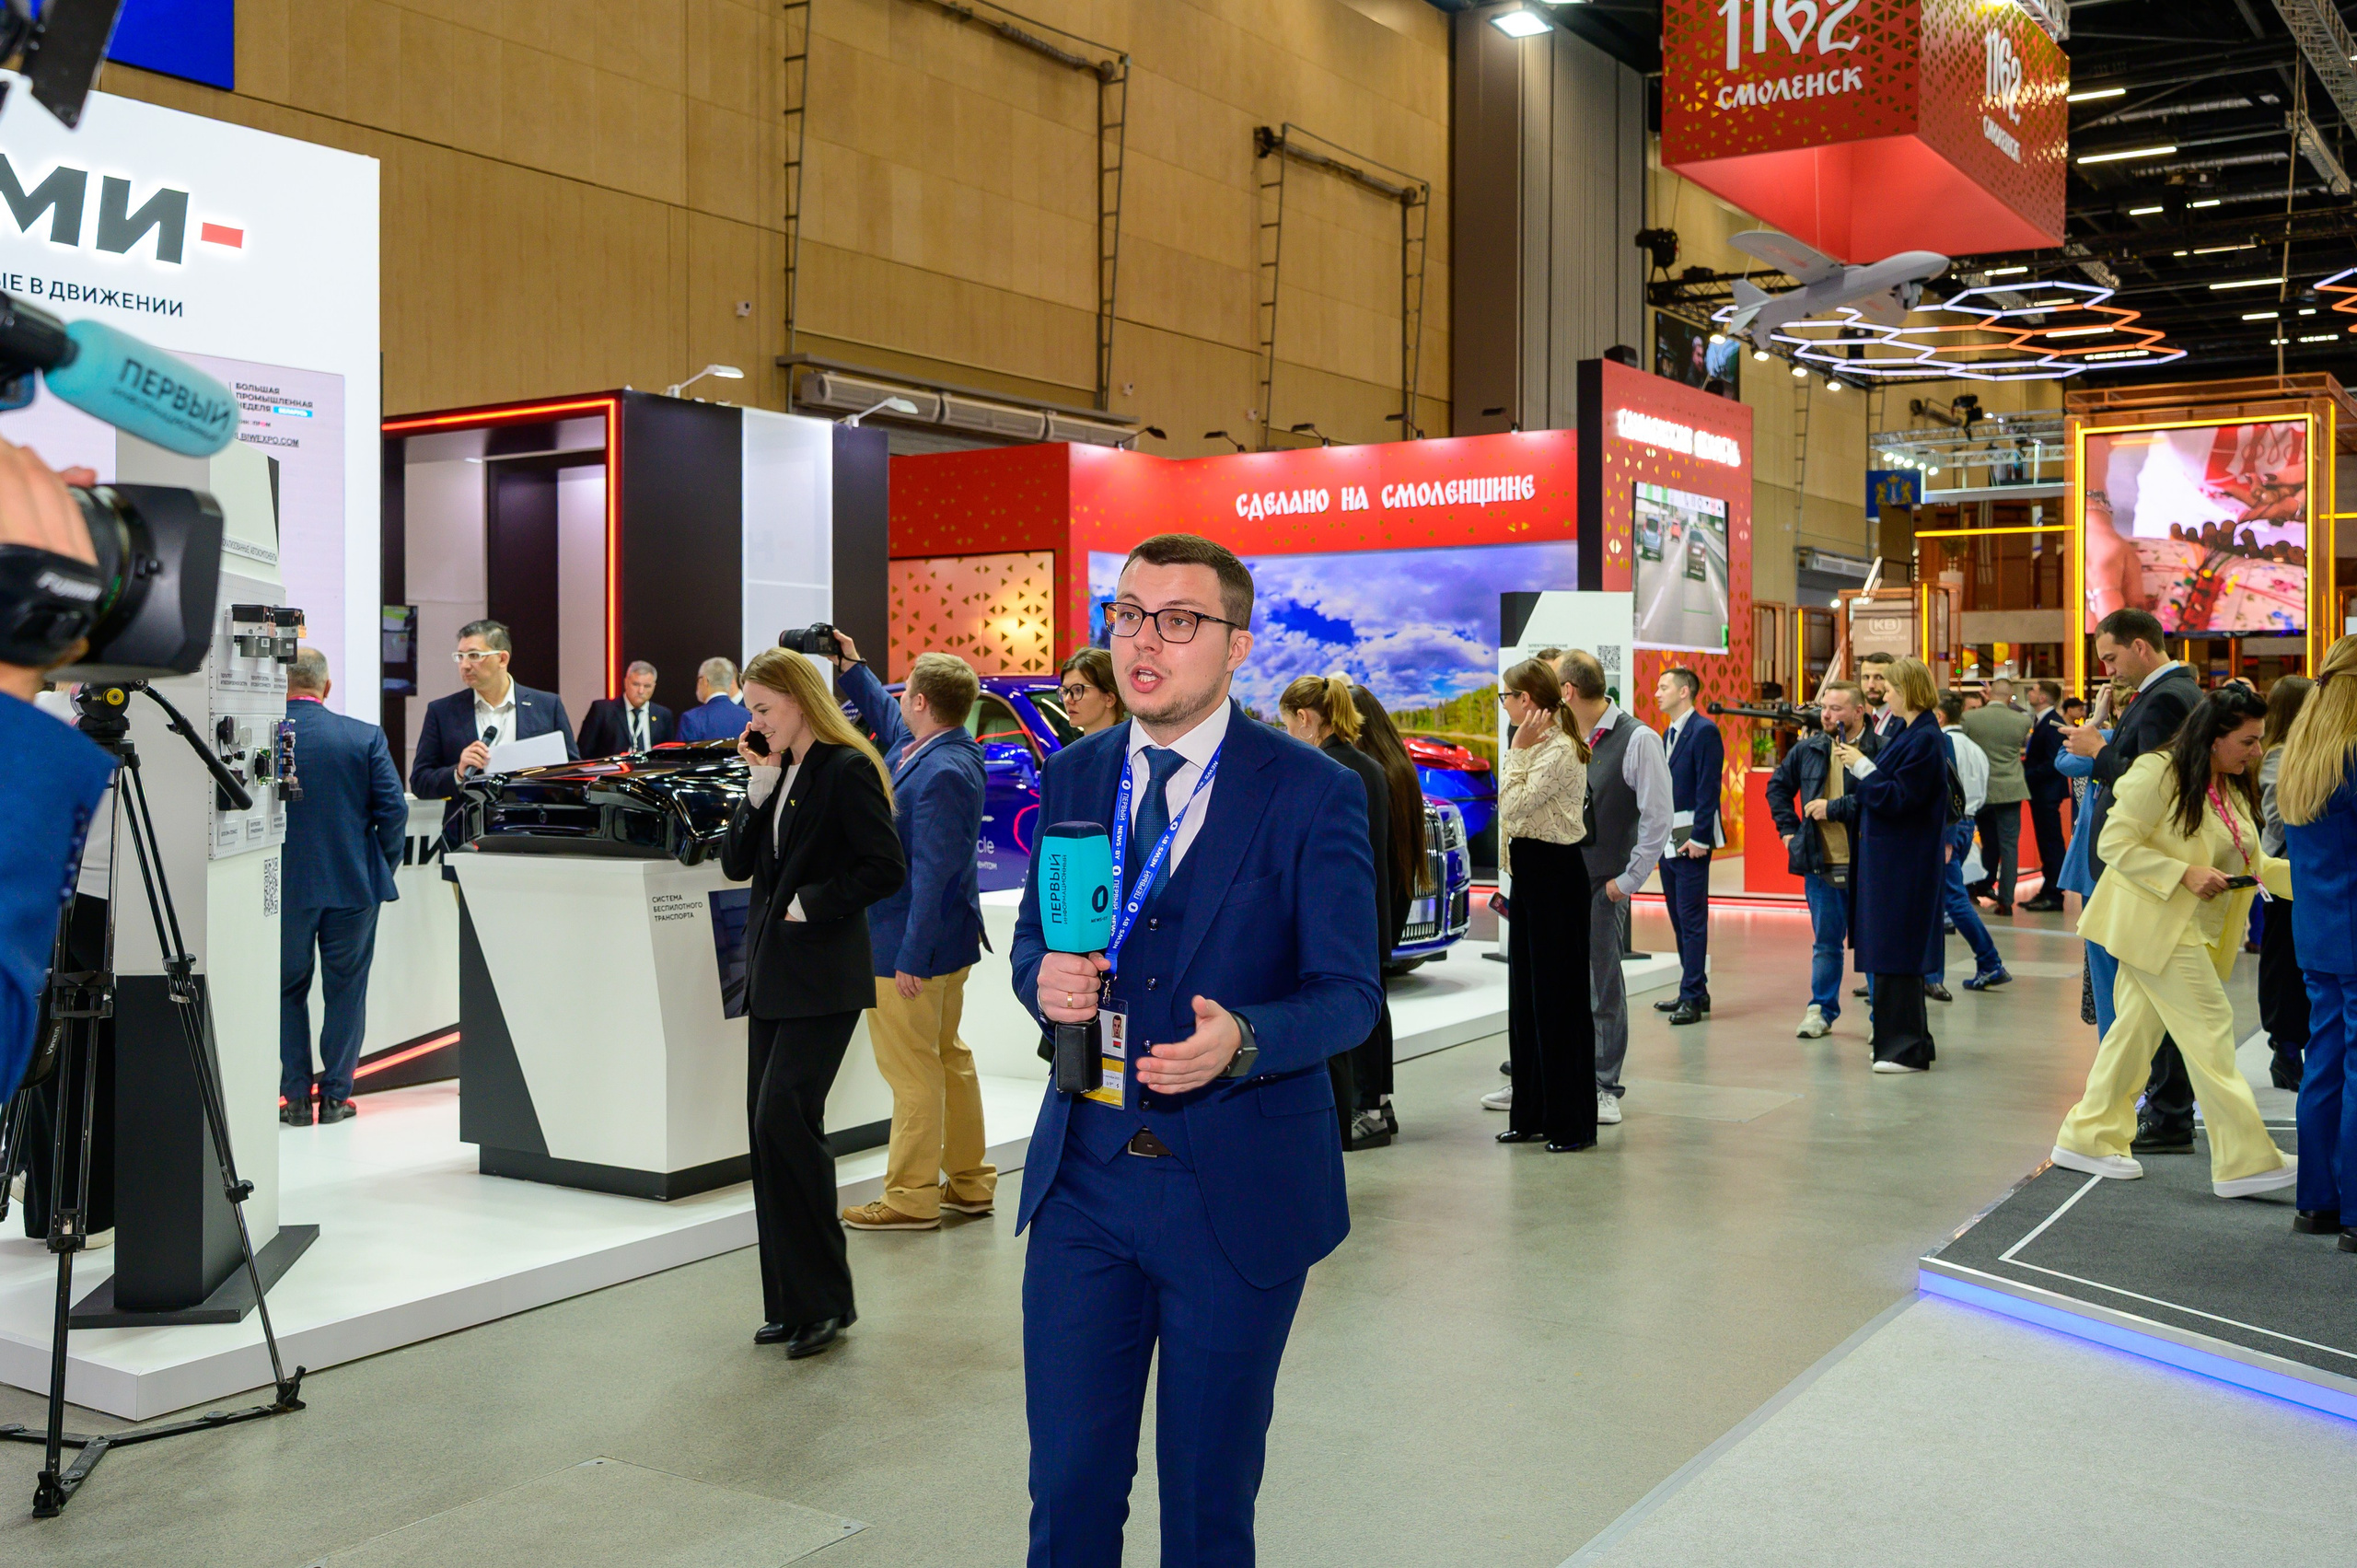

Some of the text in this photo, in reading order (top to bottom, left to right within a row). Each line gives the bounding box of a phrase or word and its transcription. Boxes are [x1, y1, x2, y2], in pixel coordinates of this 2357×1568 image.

[1716, 0, 1861, 71] 1162
[1717, 65, 1864, 110] СМОЛЕНСК
[1984, 27, 2023, 126] 1162
[30, 276, 44, 295] В
[49, 280, 183, 317] ДВИЖЕНИИ
[118, 357, 231, 432] ПЕРВЫЙ
[236, 382, 280, 394] БОЛЬШАЯ
[236, 392, 314, 409] ПРОМЫШЛЕННАЯ
[1235, 474, 1536, 522] СДЕЛАНО НА СМОЛЕНЩИНЕ
[1120, 793, 1130, 820] ПЕРВЫЙ
[652, 894, 683, 903] СИСТЕМА
[1049, 854, 1062, 923] ПЕРВЫЙ
[1060, 854, 1068, 924] ИНФОРМАЦИОННЫЙ
[1133, 869, 1152, 900] ПЕРВЫЙ
[653, 901, 703, 912] БЕСПИЛОТНОГО
[655, 912, 695, 922] ТРАНСПОРТА
